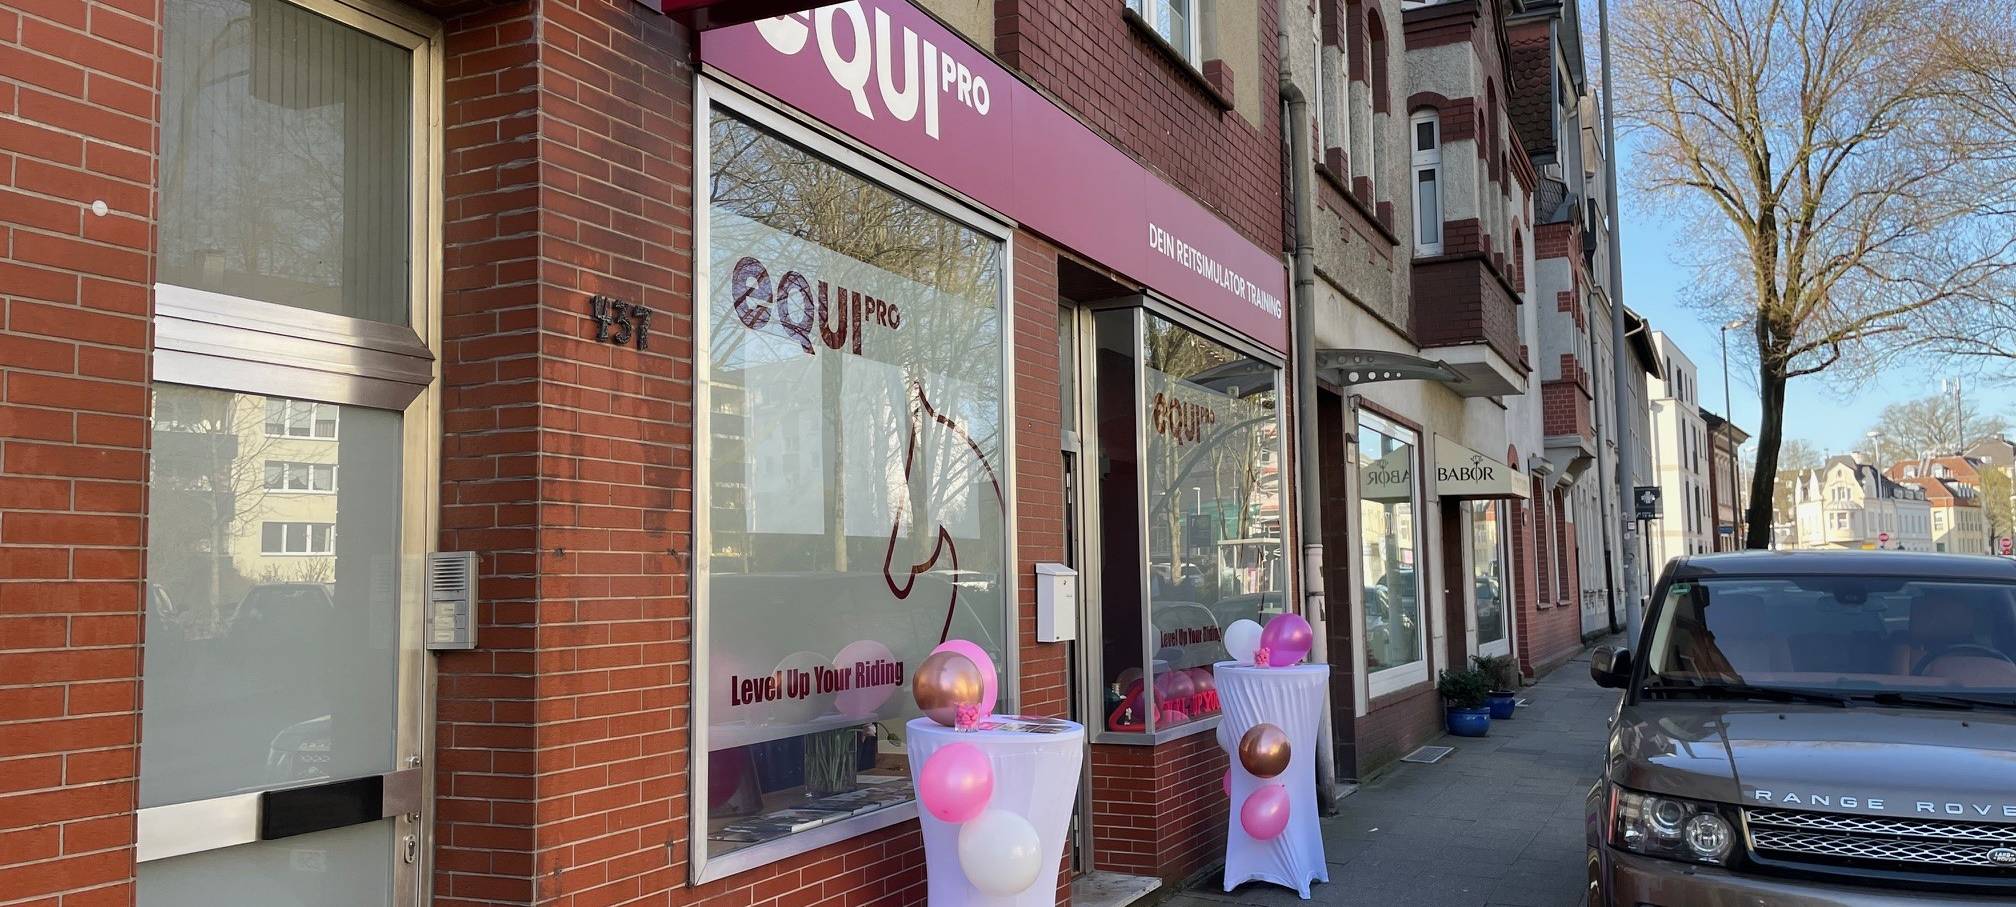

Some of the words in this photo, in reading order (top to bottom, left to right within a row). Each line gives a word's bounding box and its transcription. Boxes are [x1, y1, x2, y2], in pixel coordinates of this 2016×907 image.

[942, 52, 990, 116] PRO
[1149, 223, 1174, 260] DEIN
[1177, 240, 1246, 299] REITSIMULATOR
[1247, 281, 1282, 319] TRAINING
[865, 295, 901, 330] PRO
[1438, 466, 1495, 483] BABOR
[1160, 629, 1178, 648] Level
[1179, 628, 1187, 647] Up
[1188, 627, 1202, 644] Your
[732, 671, 782, 707] Level
[787, 669, 810, 699] Up
[814, 666, 851, 694] Your
[855, 660, 903, 688] Riding
[1755, 790, 1884, 810] RANGE
